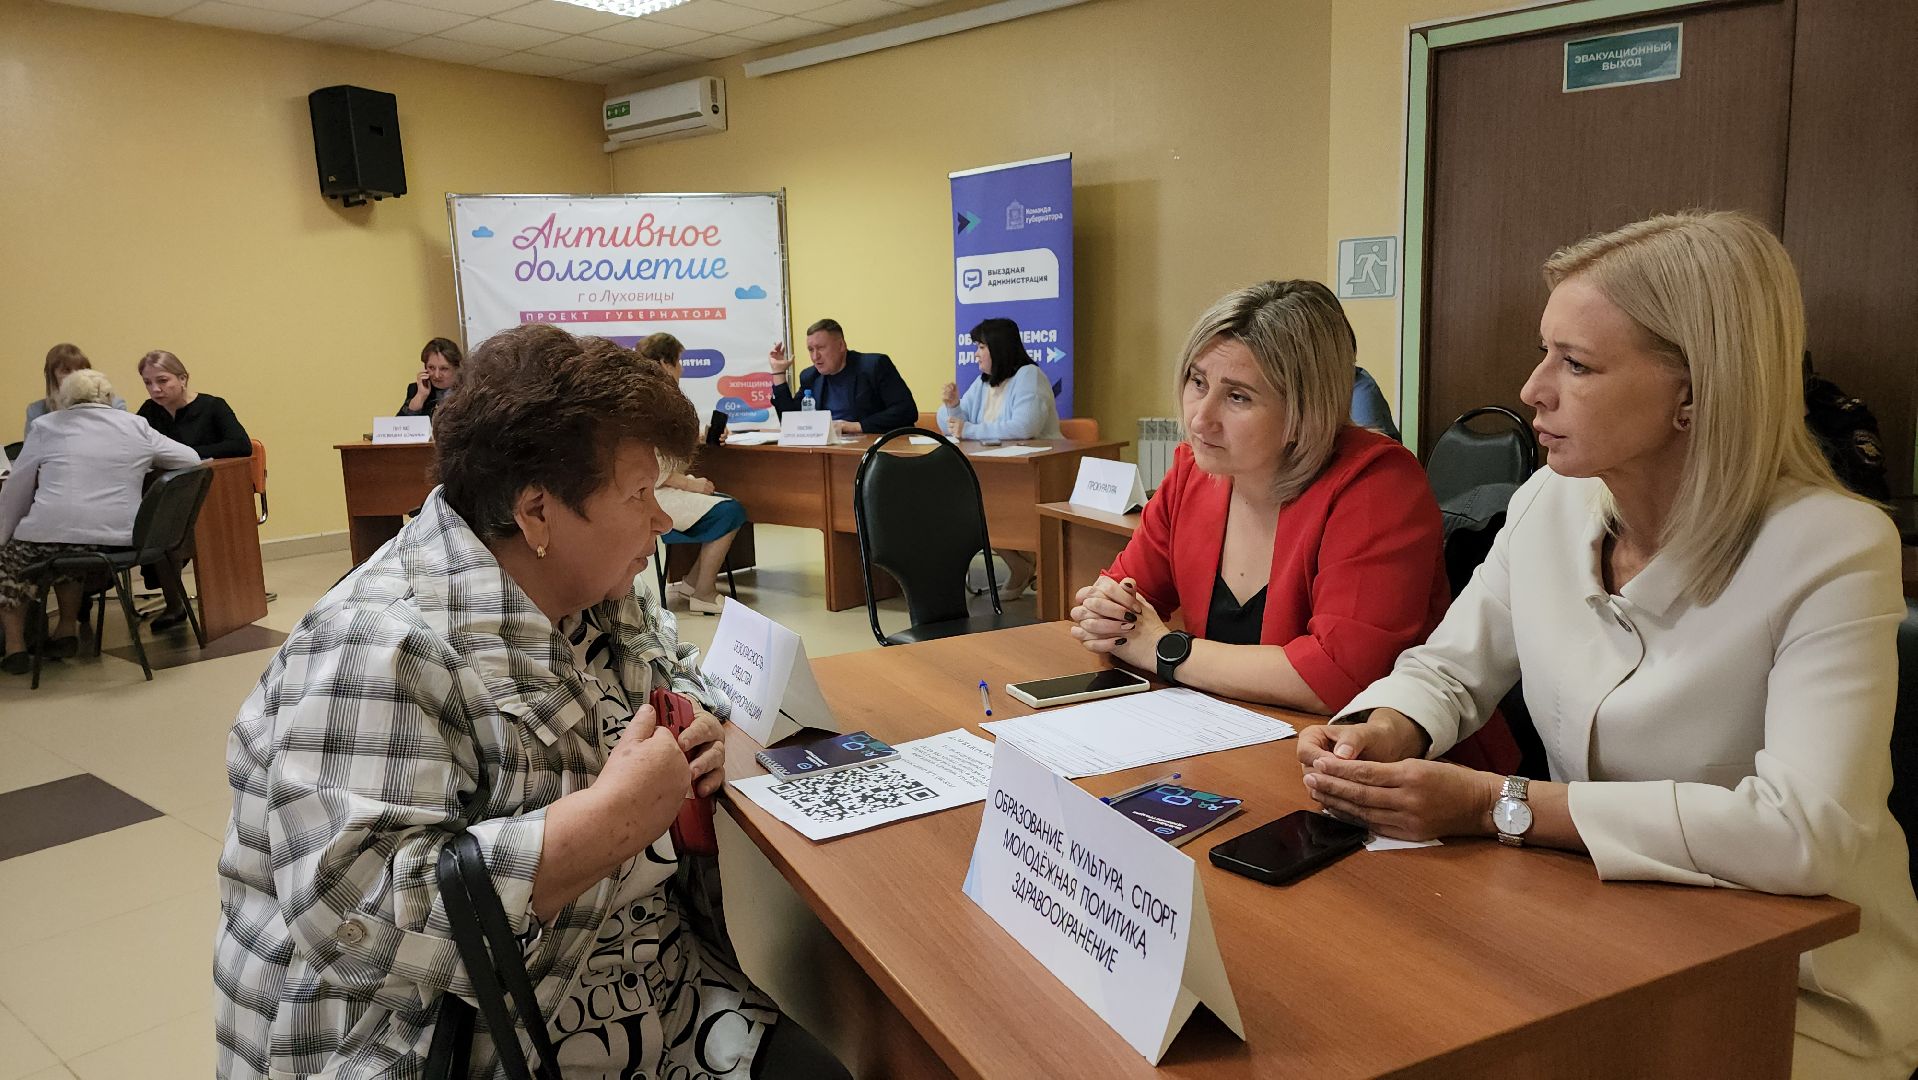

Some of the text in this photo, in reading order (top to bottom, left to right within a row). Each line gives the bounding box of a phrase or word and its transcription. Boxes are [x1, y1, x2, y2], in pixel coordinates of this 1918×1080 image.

[1574, 41, 1671, 64] ЭВАКУАЦИОННЫЙ
[1602, 57, 1641, 71] ВЫХОД
[512, 212, 721, 249] Активное
[515, 246, 729, 282] долголетие
[987, 267, 1025, 276] ВЫЕЗДНАЯ
[987, 275, 1048, 287] АДМИНИСТРАЦИЯ
[600, 288, 675, 305] Луховицы
[526, 308, 722, 321] ПРОЕКТ ГУБЕРНАТОРА
[993, 788, 1065, 856] ОБРАЗОВАНИЕ,
[1131, 883, 1178, 939] СПОРТ,
[1002, 827, 1148, 959] МОЛОДЁЖНАЯ ПОЛИТИКА,
[1011, 871, 1120, 973] ЗДРАВООХРАНЕНИЕ
